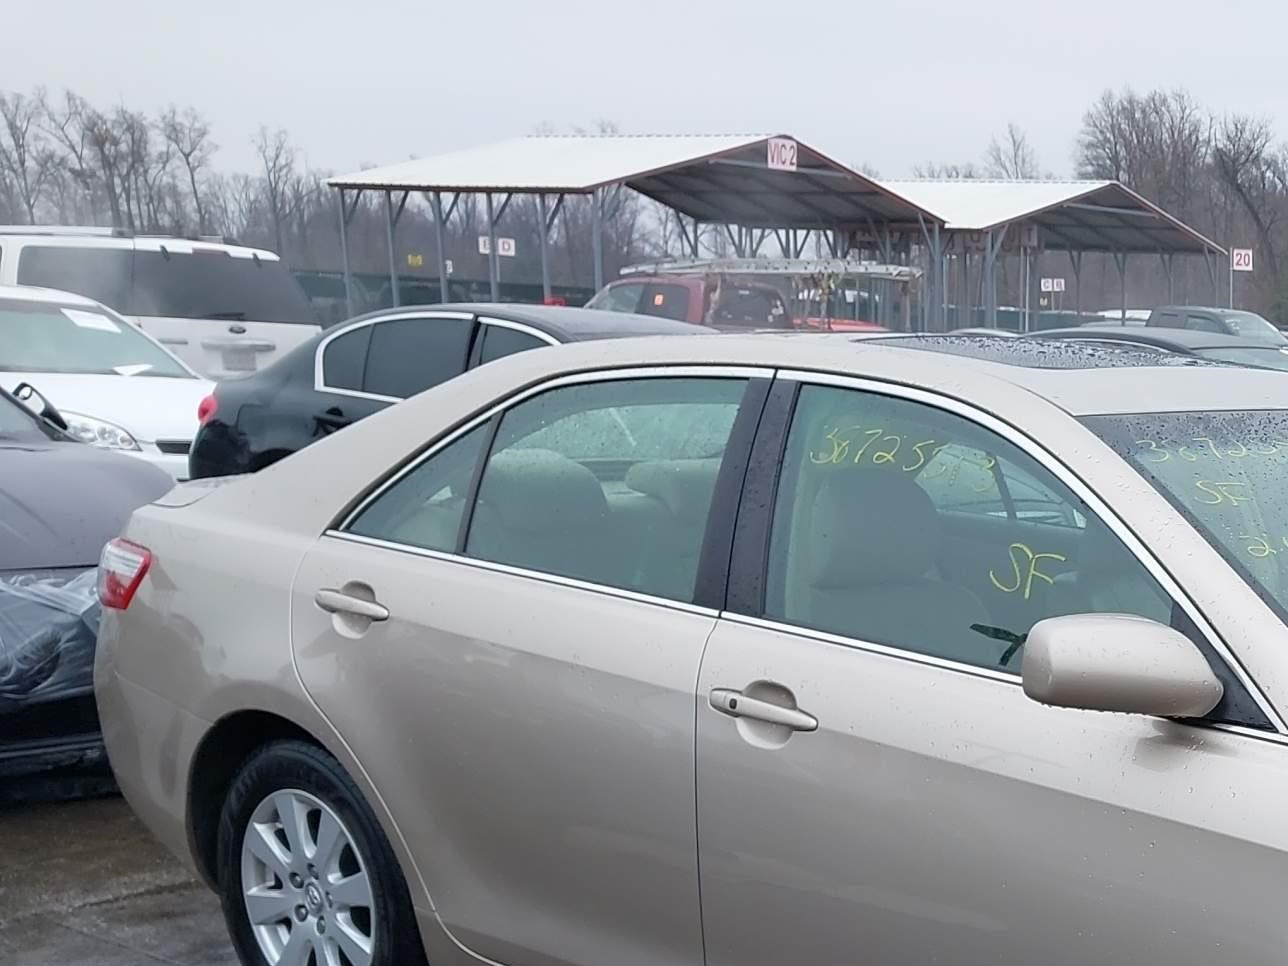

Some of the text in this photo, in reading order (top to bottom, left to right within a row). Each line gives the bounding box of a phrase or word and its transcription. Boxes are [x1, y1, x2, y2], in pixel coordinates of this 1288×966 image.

[769, 143, 796, 166] VIC 2
[1235, 252, 1250, 267] 20
[989, 543, 1066, 600] SF
